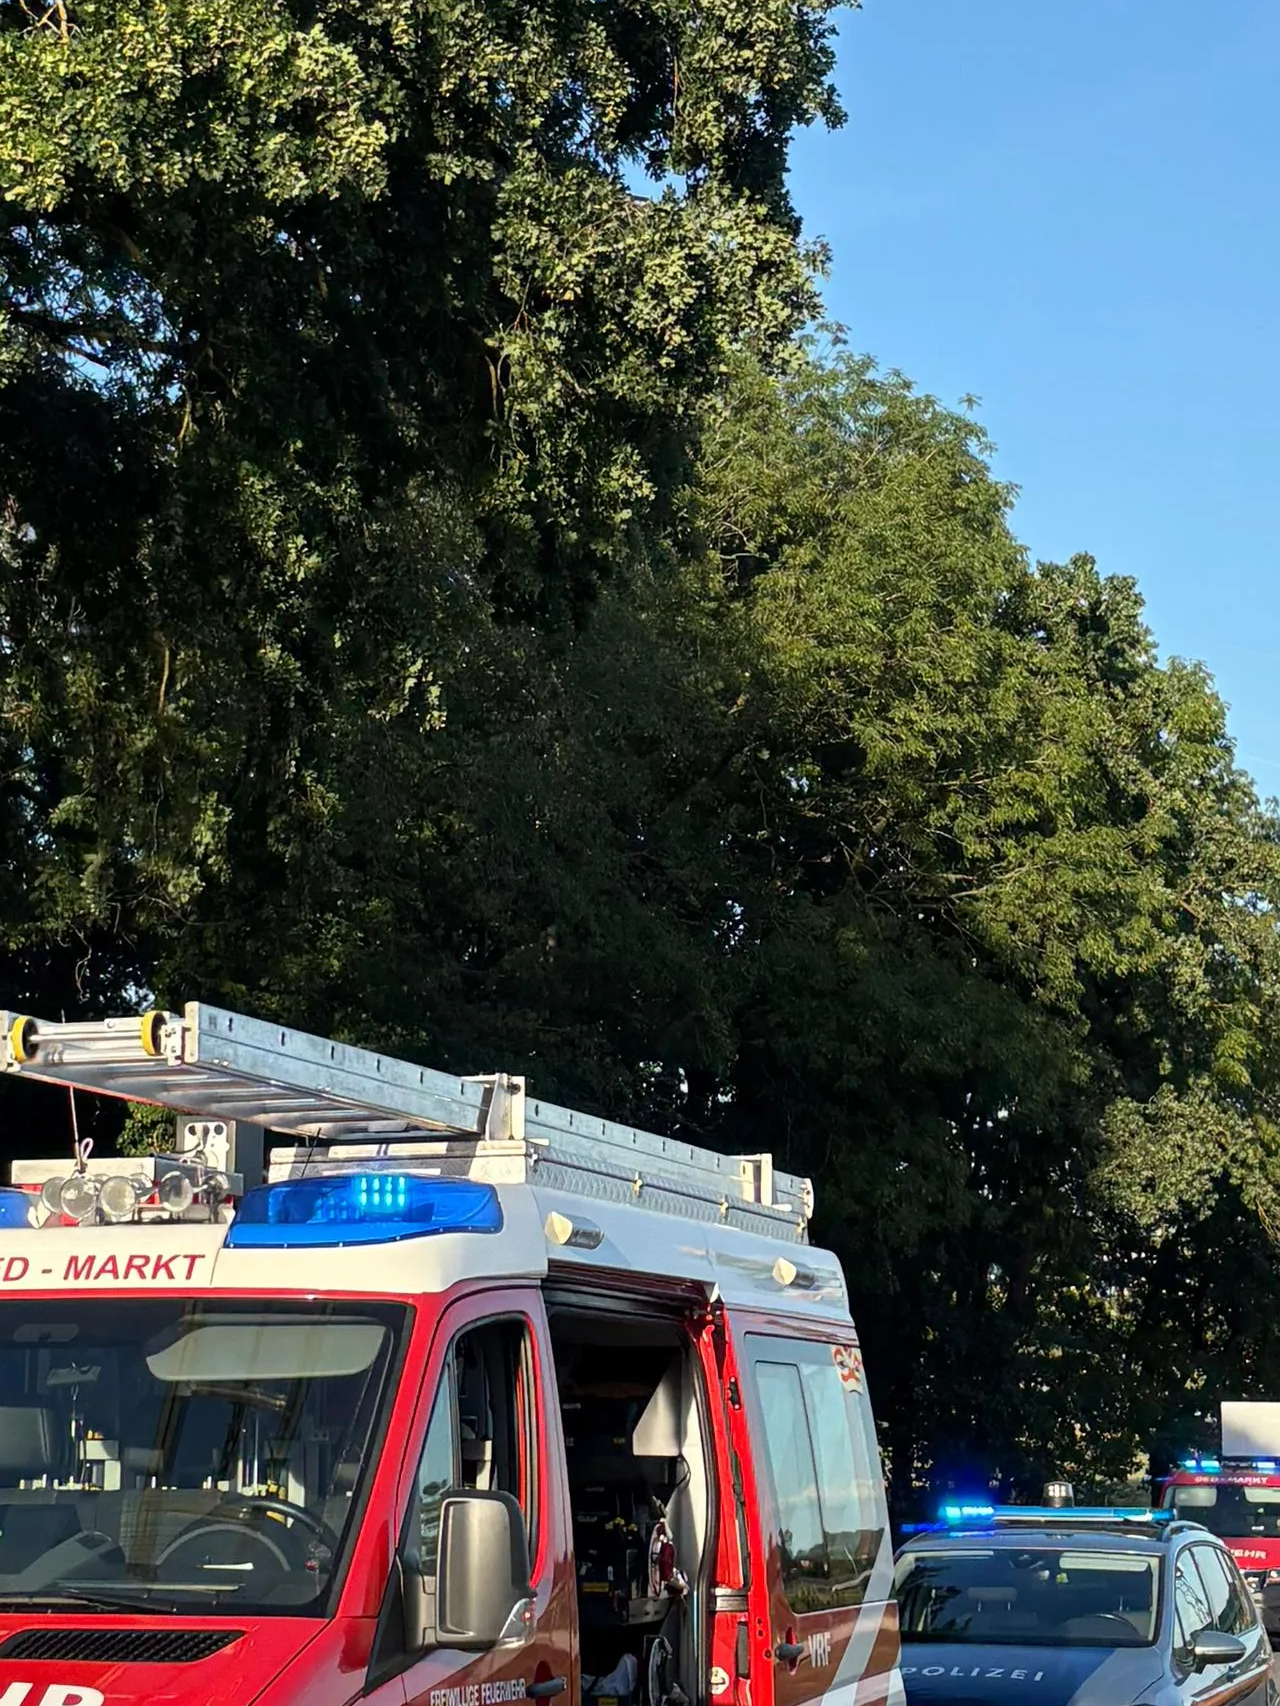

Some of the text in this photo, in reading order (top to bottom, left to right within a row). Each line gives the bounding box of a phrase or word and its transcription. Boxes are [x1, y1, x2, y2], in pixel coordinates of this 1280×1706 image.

[63, 1254, 206, 1281] MARKT
[808, 1631, 832, 1669] VRF
[901, 1666, 1045, 1682] POLIZEI
[481, 1678, 528, 1706] FEUERWEHR
